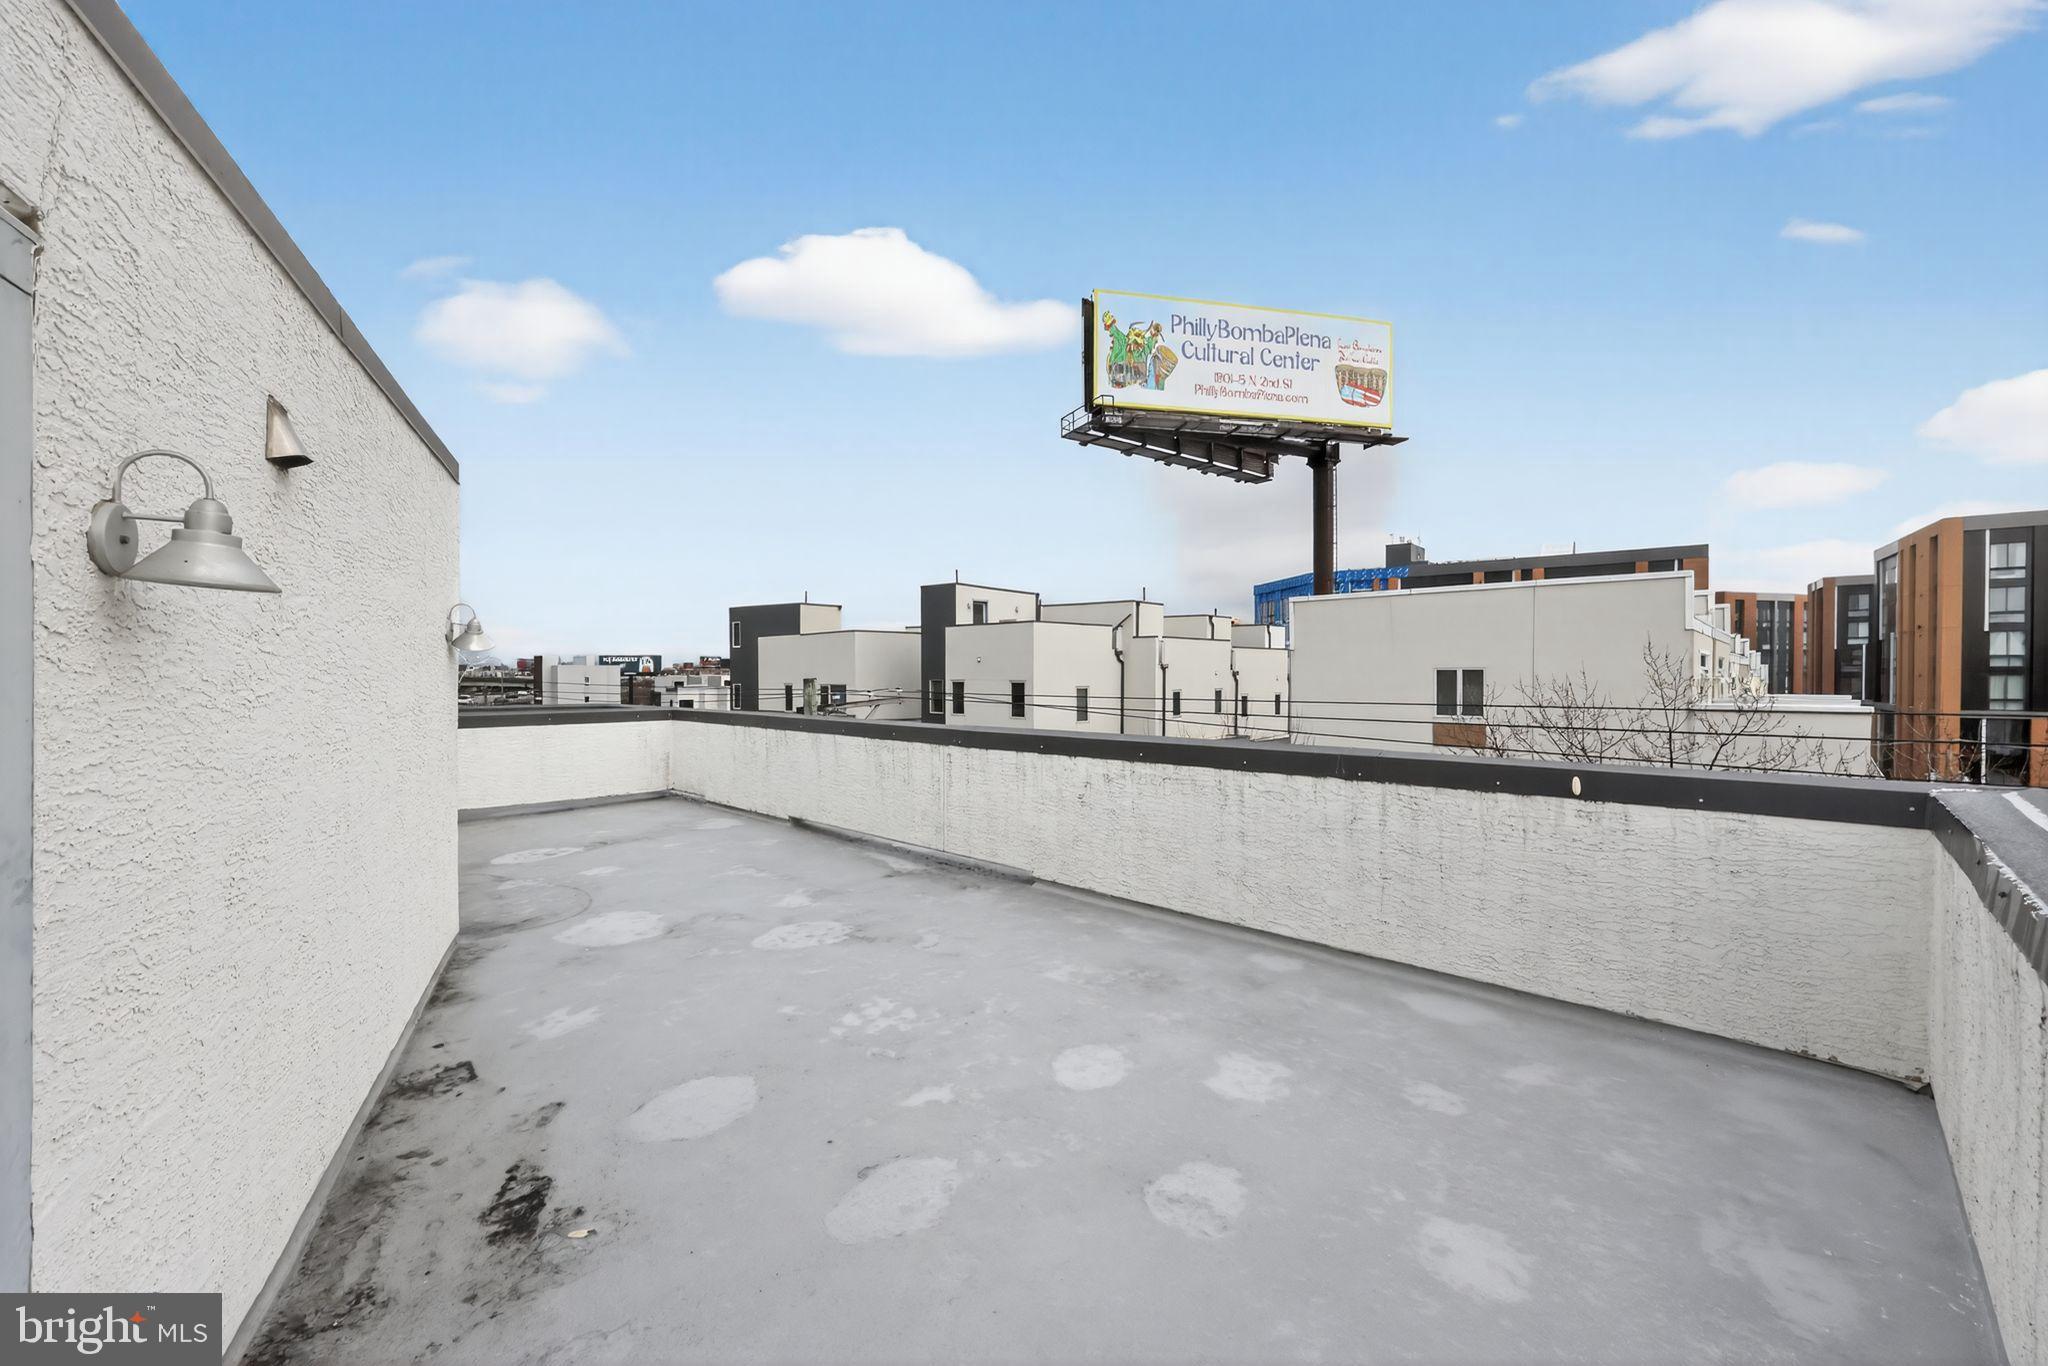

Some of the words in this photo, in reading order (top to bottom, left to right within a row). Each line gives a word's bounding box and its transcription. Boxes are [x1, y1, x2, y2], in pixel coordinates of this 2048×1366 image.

[1171, 314, 1332, 349] PhillyBombaPlena
[1181, 340, 1254, 366] Cultural
[1260, 347, 1321, 371] Center
[1250, 375, 1257, 386] N
[1260, 376, 1280, 388] 2nd
